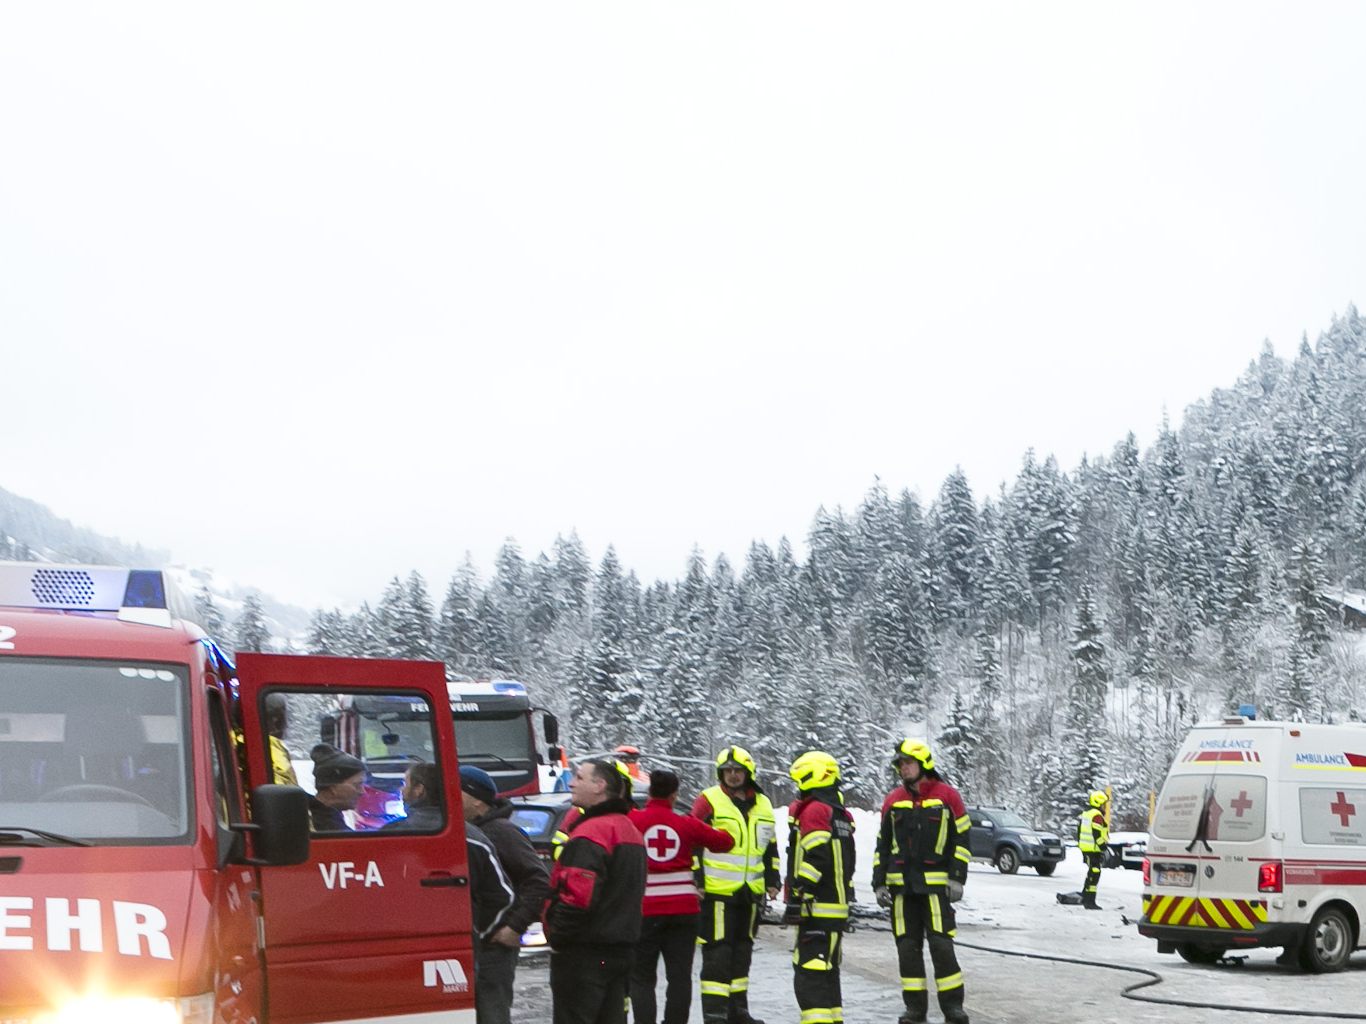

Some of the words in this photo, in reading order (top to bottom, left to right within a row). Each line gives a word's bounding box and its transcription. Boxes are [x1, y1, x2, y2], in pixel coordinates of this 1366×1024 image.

[1200, 738, 1256, 749] AMBULANCE
[1295, 752, 1345, 765] AMBULANCE
[318, 860, 384, 890] VF-A
[0, 896, 174, 960] EHR
